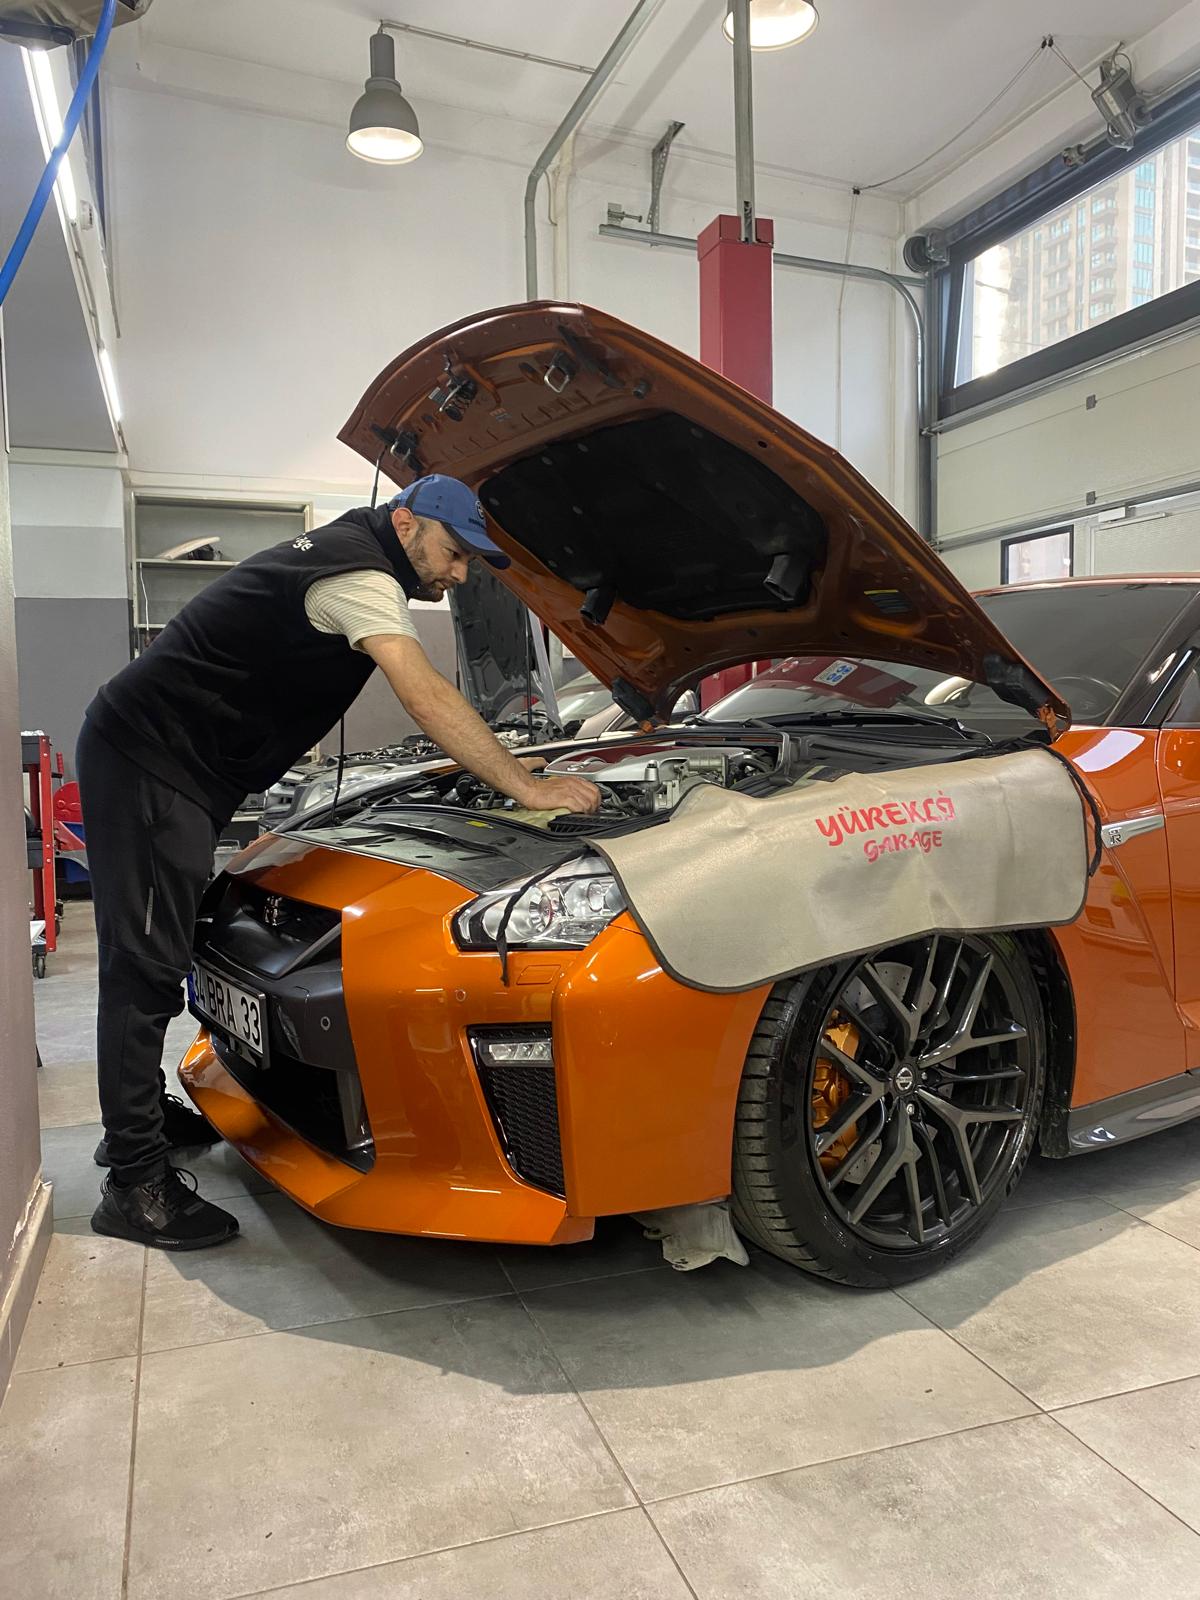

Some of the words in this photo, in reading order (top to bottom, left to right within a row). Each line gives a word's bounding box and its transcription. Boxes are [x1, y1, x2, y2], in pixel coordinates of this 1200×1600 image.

[863, 830, 943, 863] GARAGE
[206, 974, 238, 1032] BRA
[240, 995, 261, 1046] 33
